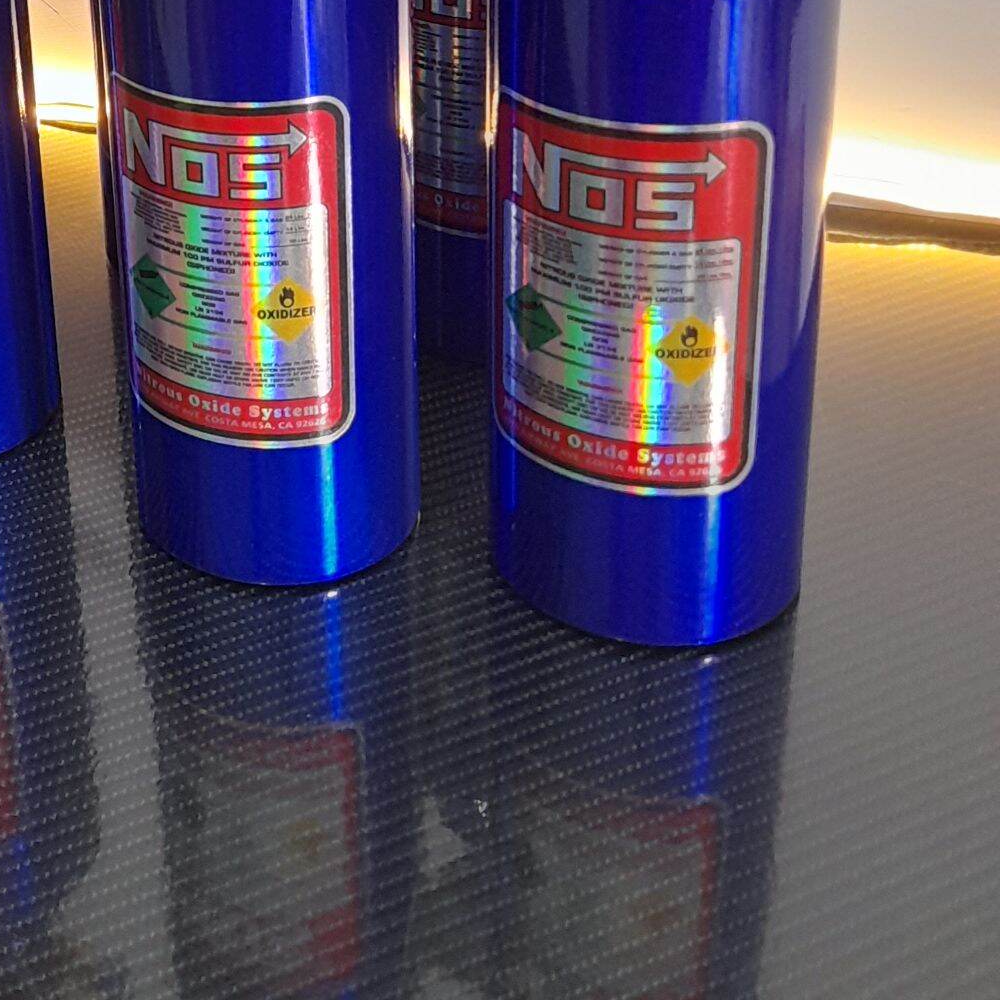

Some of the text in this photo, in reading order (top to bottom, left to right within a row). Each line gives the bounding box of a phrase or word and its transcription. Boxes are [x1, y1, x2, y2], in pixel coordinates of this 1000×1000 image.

[124, 109, 285, 202] NOS
[513, 128, 697, 232] NOS
[257, 306, 316, 320] OXIDIZER
[655, 347, 717, 359] OXIDIZE
[140, 367, 183, 402] itrous
[188, 394, 242, 417] Oxide
[249, 402, 329, 421] Systems
[205, 415, 238, 427] COSTA
[277, 421, 293, 429] CA
[567, 434, 629, 460] Oxide
[636, 448, 725, 466] Systems
